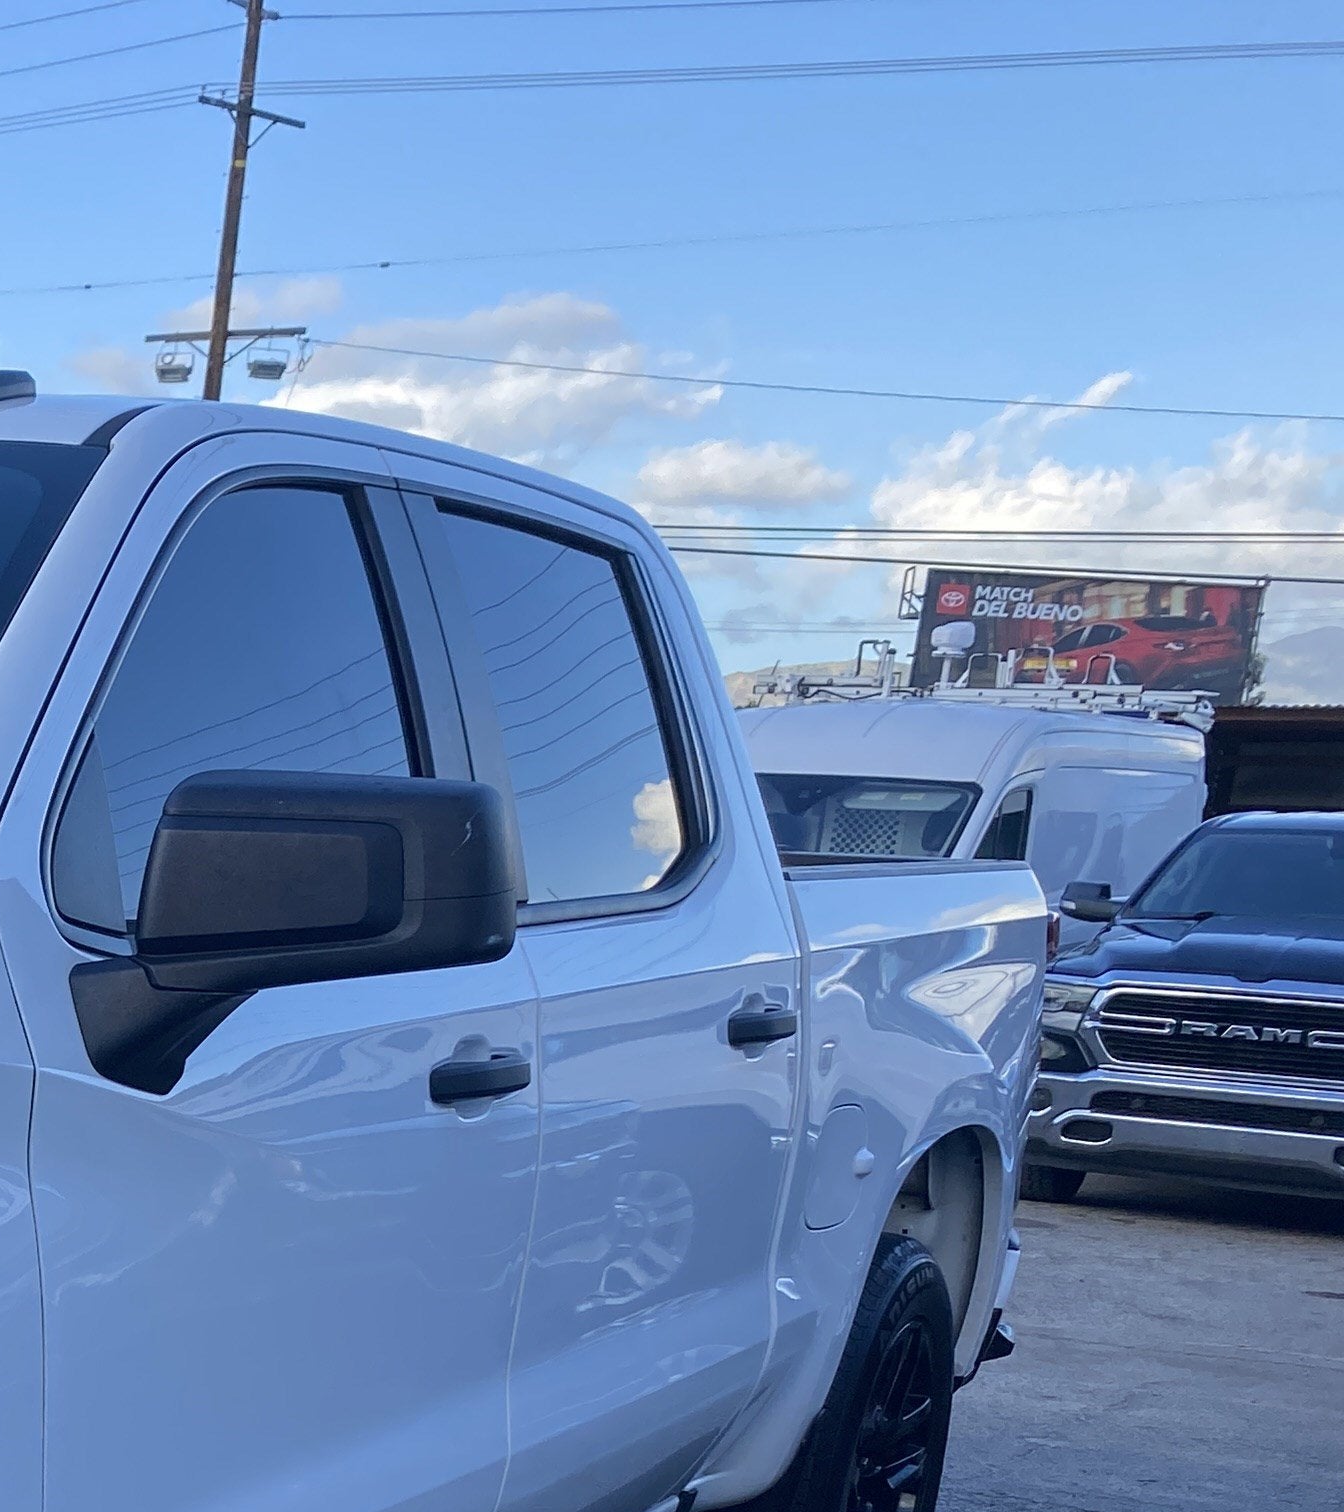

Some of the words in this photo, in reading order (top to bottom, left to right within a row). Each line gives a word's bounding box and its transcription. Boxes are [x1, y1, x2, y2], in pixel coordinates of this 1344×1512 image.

[974, 585, 1034, 602] MATCH
[972, 599, 1009, 618] DEL
[1012, 602, 1083, 622] BUENO
[1180, 1019, 1303, 1044] RAM
